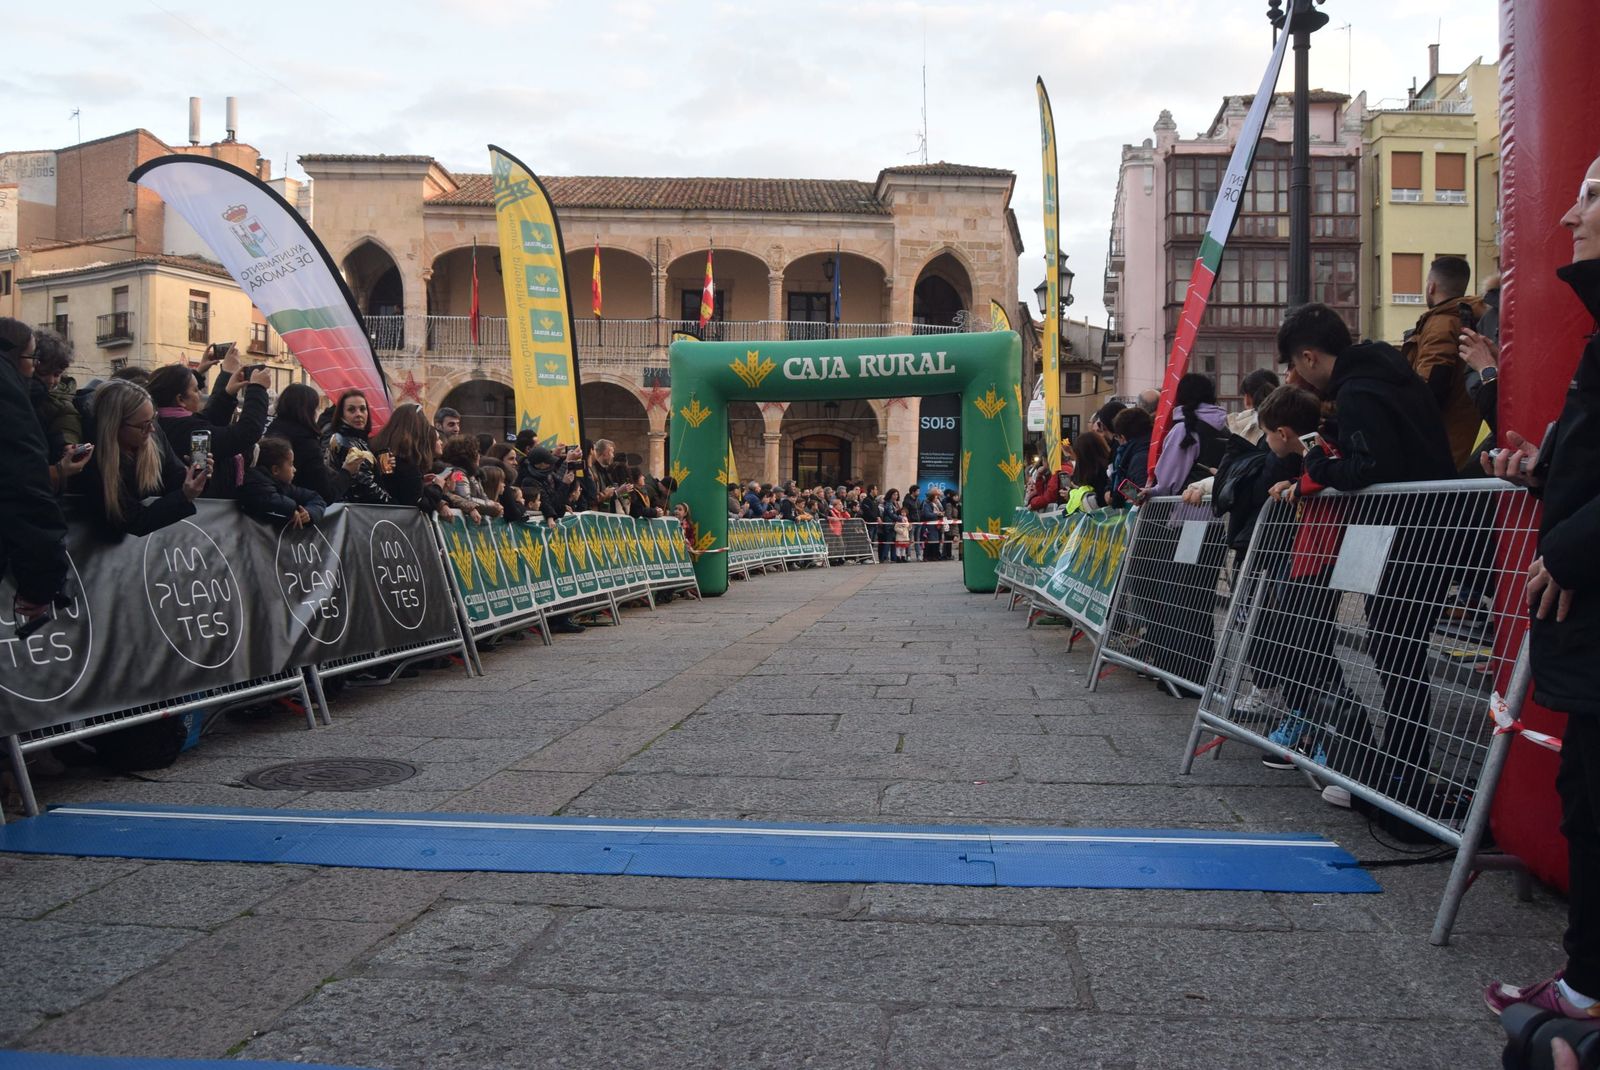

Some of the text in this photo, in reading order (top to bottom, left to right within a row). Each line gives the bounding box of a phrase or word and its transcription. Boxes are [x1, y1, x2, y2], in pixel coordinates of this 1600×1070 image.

[783, 351, 956, 381] CAJA RURAL
[164, 546, 208, 572] IM
[291, 543, 322, 564] IM
[380, 541, 405, 559] IM
[302, 596, 340, 620] TES
[390, 589, 420, 608] TES
[177, 611, 229, 641] TES
[0, 631, 72, 667] TES
